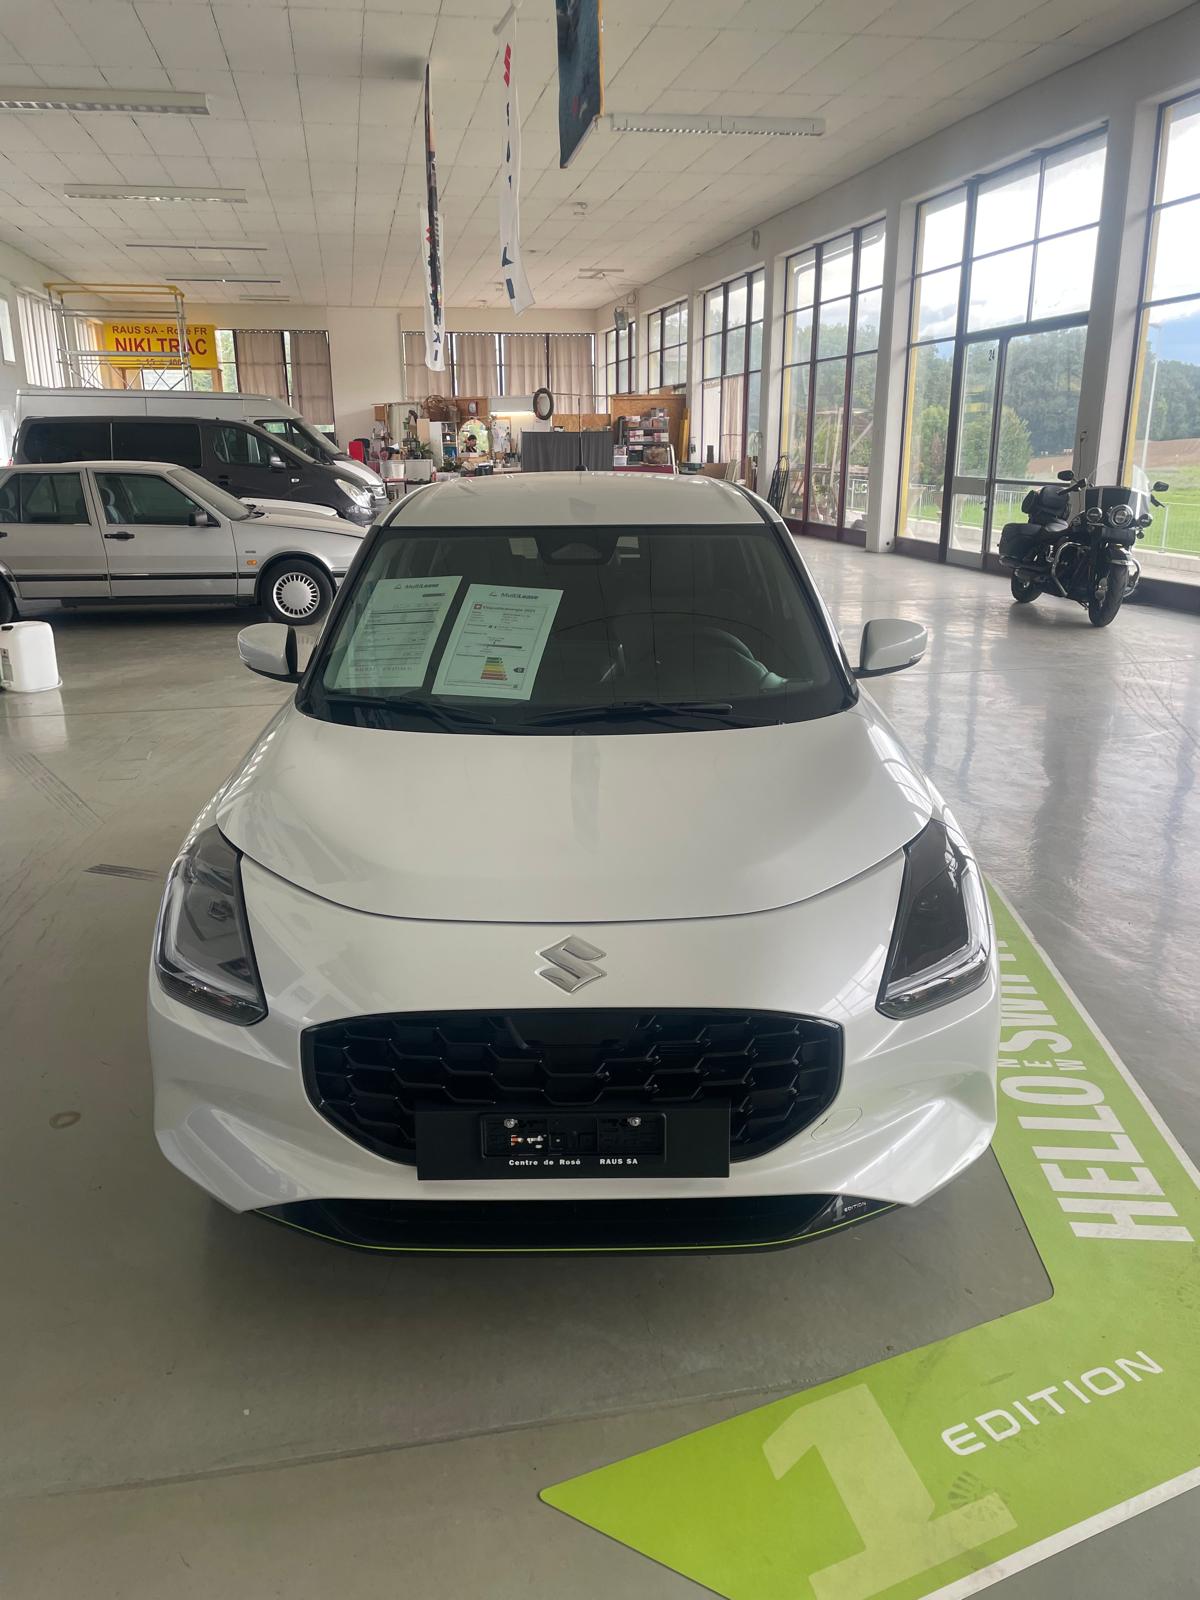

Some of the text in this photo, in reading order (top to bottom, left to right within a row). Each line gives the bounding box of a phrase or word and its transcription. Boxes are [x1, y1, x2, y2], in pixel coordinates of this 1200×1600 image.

[112, 325, 142, 335] RAUS
[144, 326, 158, 335] SA
[194, 327, 208, 336] FR
[115, 337, 208, 356] NIKI TRAC
[559, 1158, 581, 1166] Rosé
[1000, 1075, 1196, 1243] HELLO
[844, 1201, 867, 1213] EDITION
[940, 1350, 1164, 1456] EDITION
